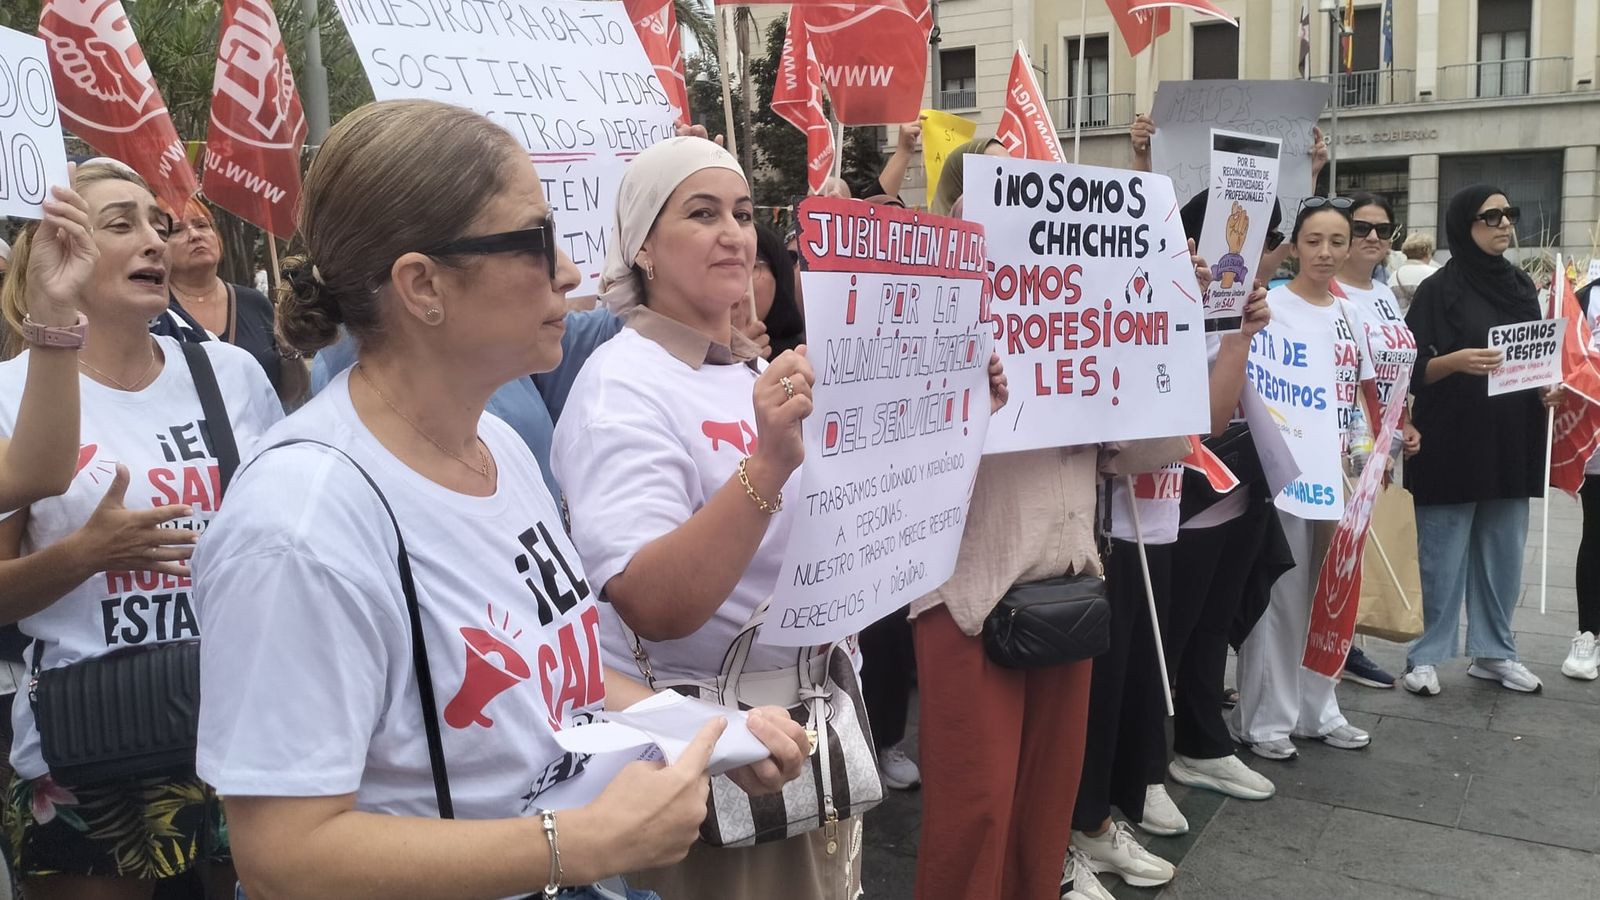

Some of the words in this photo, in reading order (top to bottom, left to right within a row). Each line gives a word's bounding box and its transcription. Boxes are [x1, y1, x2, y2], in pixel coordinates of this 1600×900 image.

[371, 47, 578, 102] SOSTIENE
[579, 70, 671, 113] VIDAS,
[1370, 129, 1440, 144] GOBIERNO
[1222, 166, 1263, 180] RECONOCIMIENTO
[1262, 170, 1270, 181] DE
[1237, 156, 1249, 167] POR
[1249, 158, 1257, 168] EL
[1224, 189, 1265, 203] PROFESIONALES
[1227, 178, 1265, 191] ENFERMEDADES
[877, 282, 921, 325] POR
[932, 285, 960, 323] LA
[1491, 322, 1557, 347] EXIGIMOS
[1282, 337, 1308, 369] DE
[1506, 340, 1557, 362] RESPETO
[821, 406, 867, 458] DEL
[806, 476, 878, 517] TRABAJAMOS
[919, 465, 925, 480] Y
[835, 525, 847, 548] A
[793, 552, 855, 587] NUESTRO
[858, 535, 896, 568] TRABAJO
[898, 519, 927, 549] MERECE
[514, 520, 591, 627] ¡EL
[780, 589, 866, 629] DERECHOS
[872, 579, 882, 604] Y
